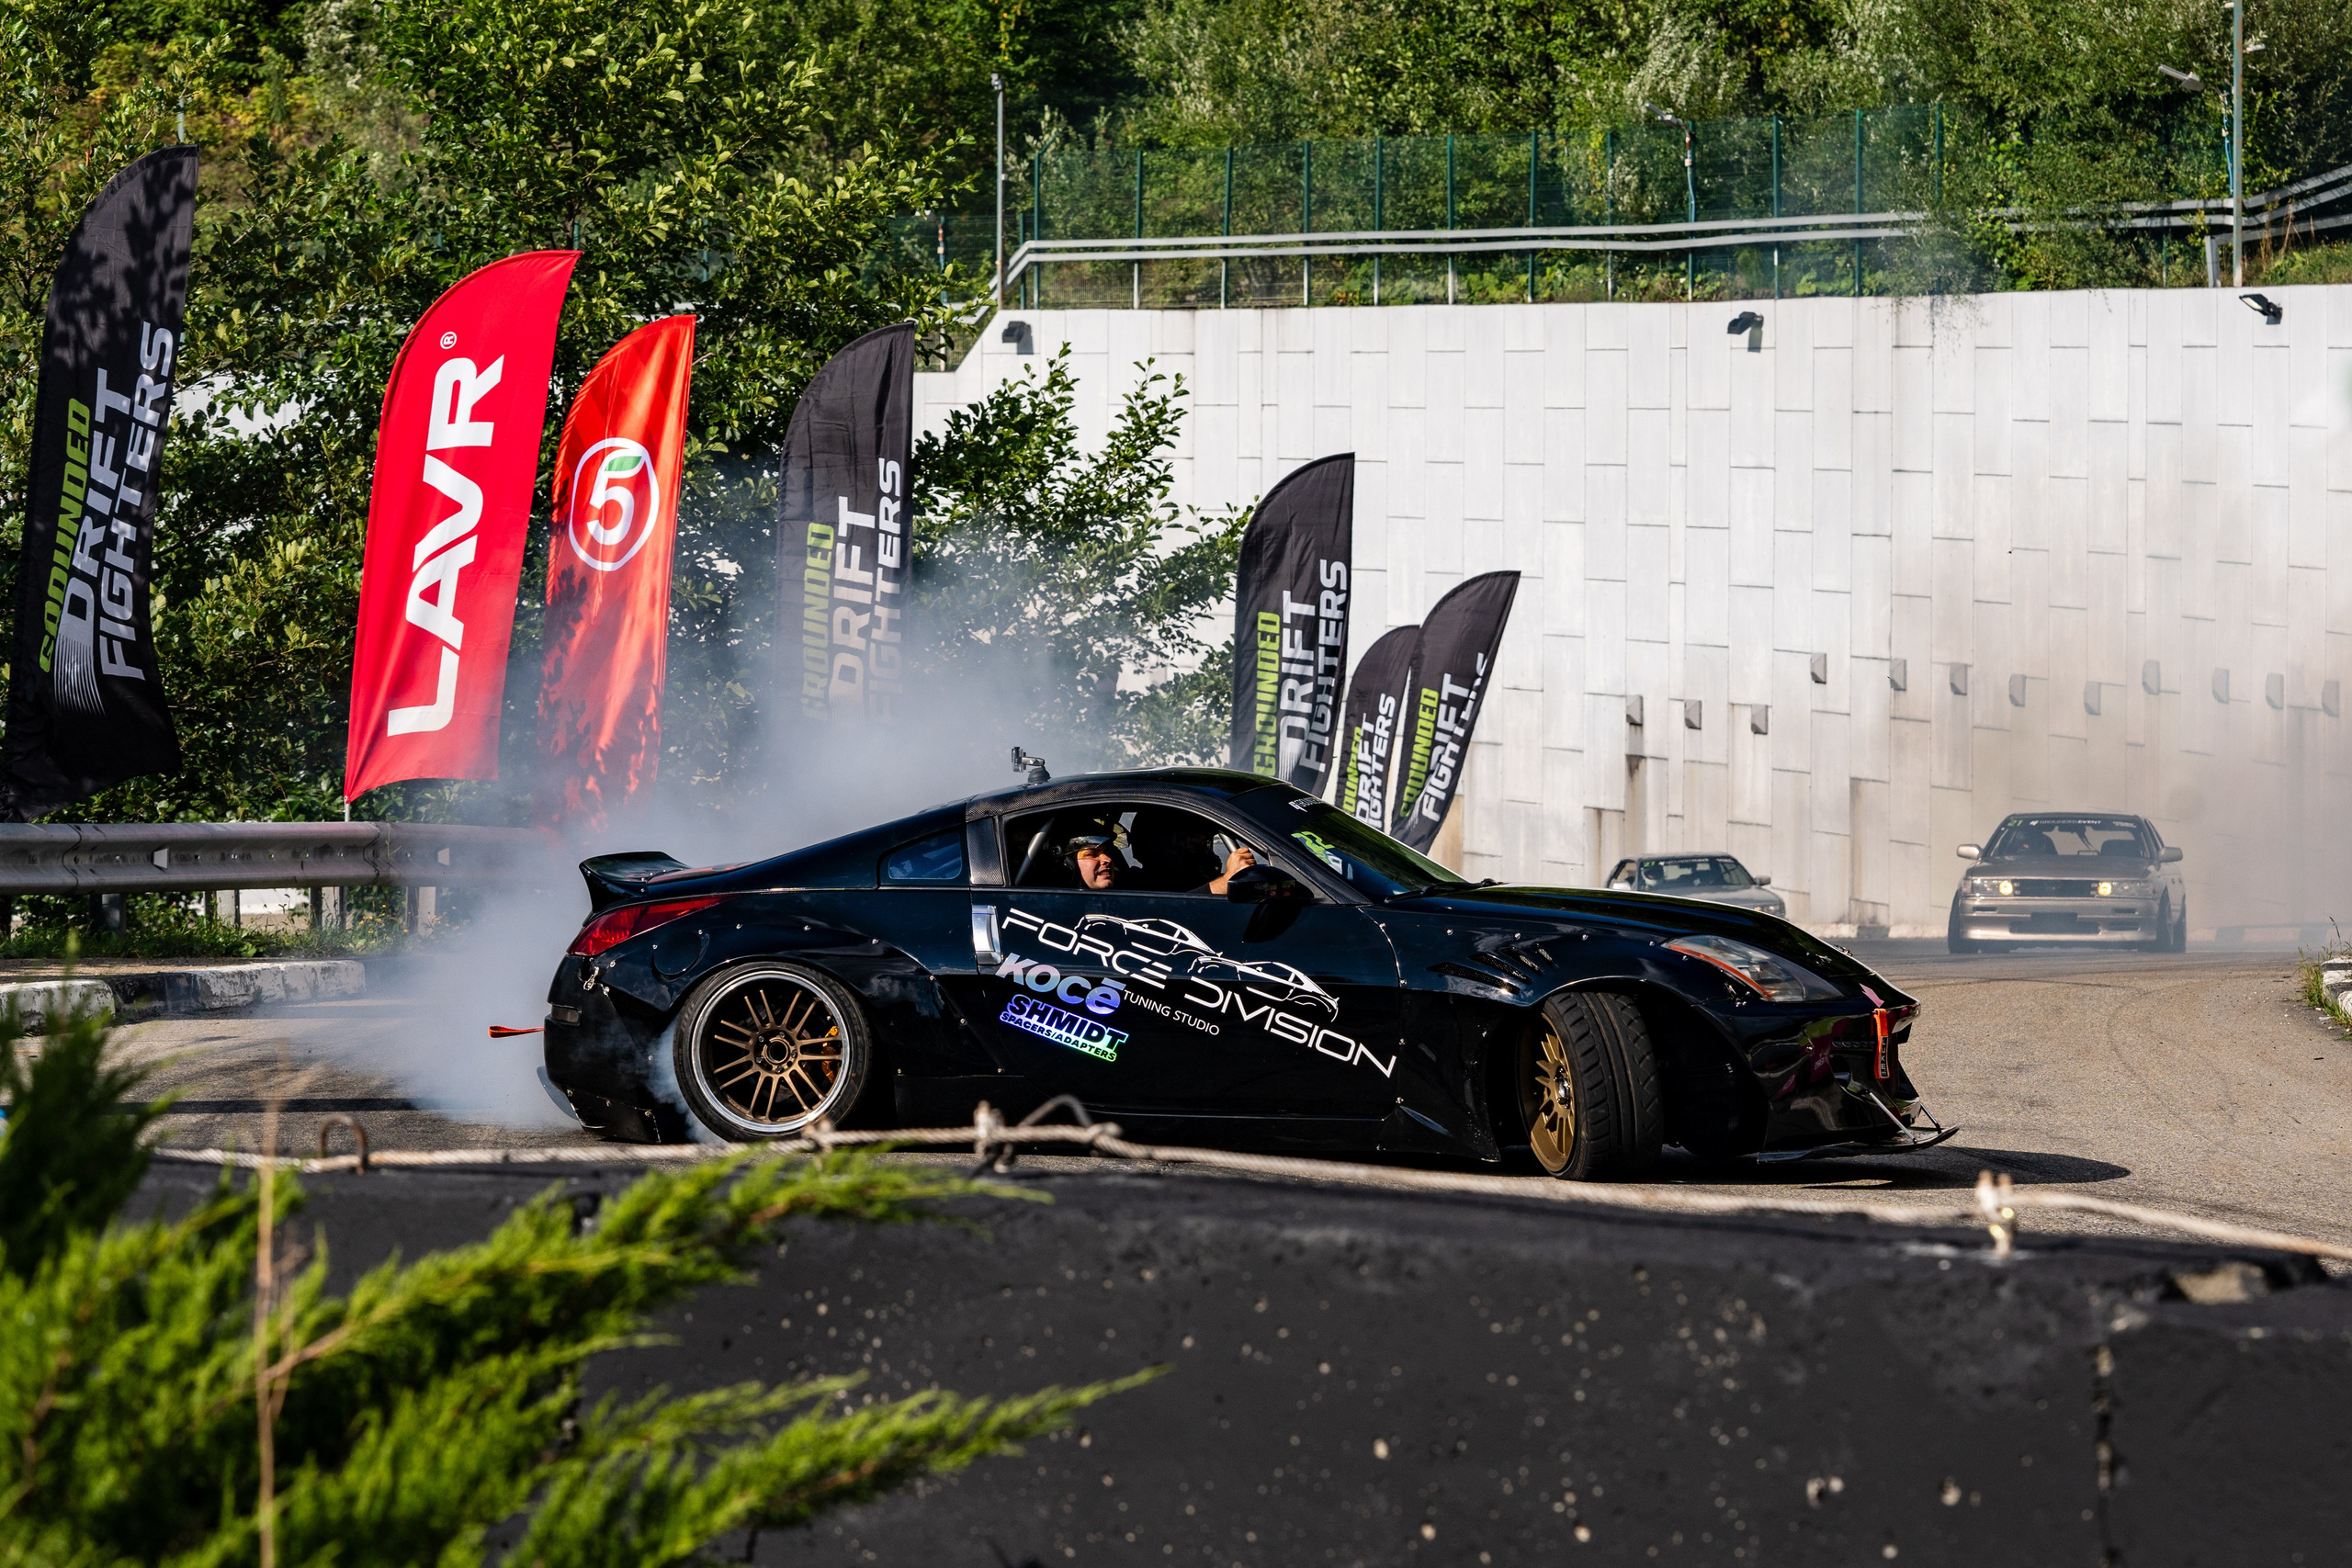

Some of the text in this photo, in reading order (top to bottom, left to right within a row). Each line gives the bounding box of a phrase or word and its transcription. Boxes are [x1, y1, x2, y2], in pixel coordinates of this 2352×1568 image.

[57, 368, 135, 675] DRIFT
[98, 321, 174, 682] FIGHTERS
[387, 355, 504, 737] LAVR
[586, 456, 644, 546] 5
[829, 496, 876, 709] DRIFT
[1279, 590, 1316, 764] DRIFT
[1299, 558, 1348, 773] FIGHTERS
[1253, 611, 1280, 776] GROUNDED
[1355, 713, 1375, 823] DRIFT
[1368, 693, 1396, 829] IGHTERS
[1001, 908, 1397, 1078] FORCE DIVISION
[1006, 994, 1129, 1051] SHMIDT
[1123, 988, 1220, 1036] TUNING STUDIO
